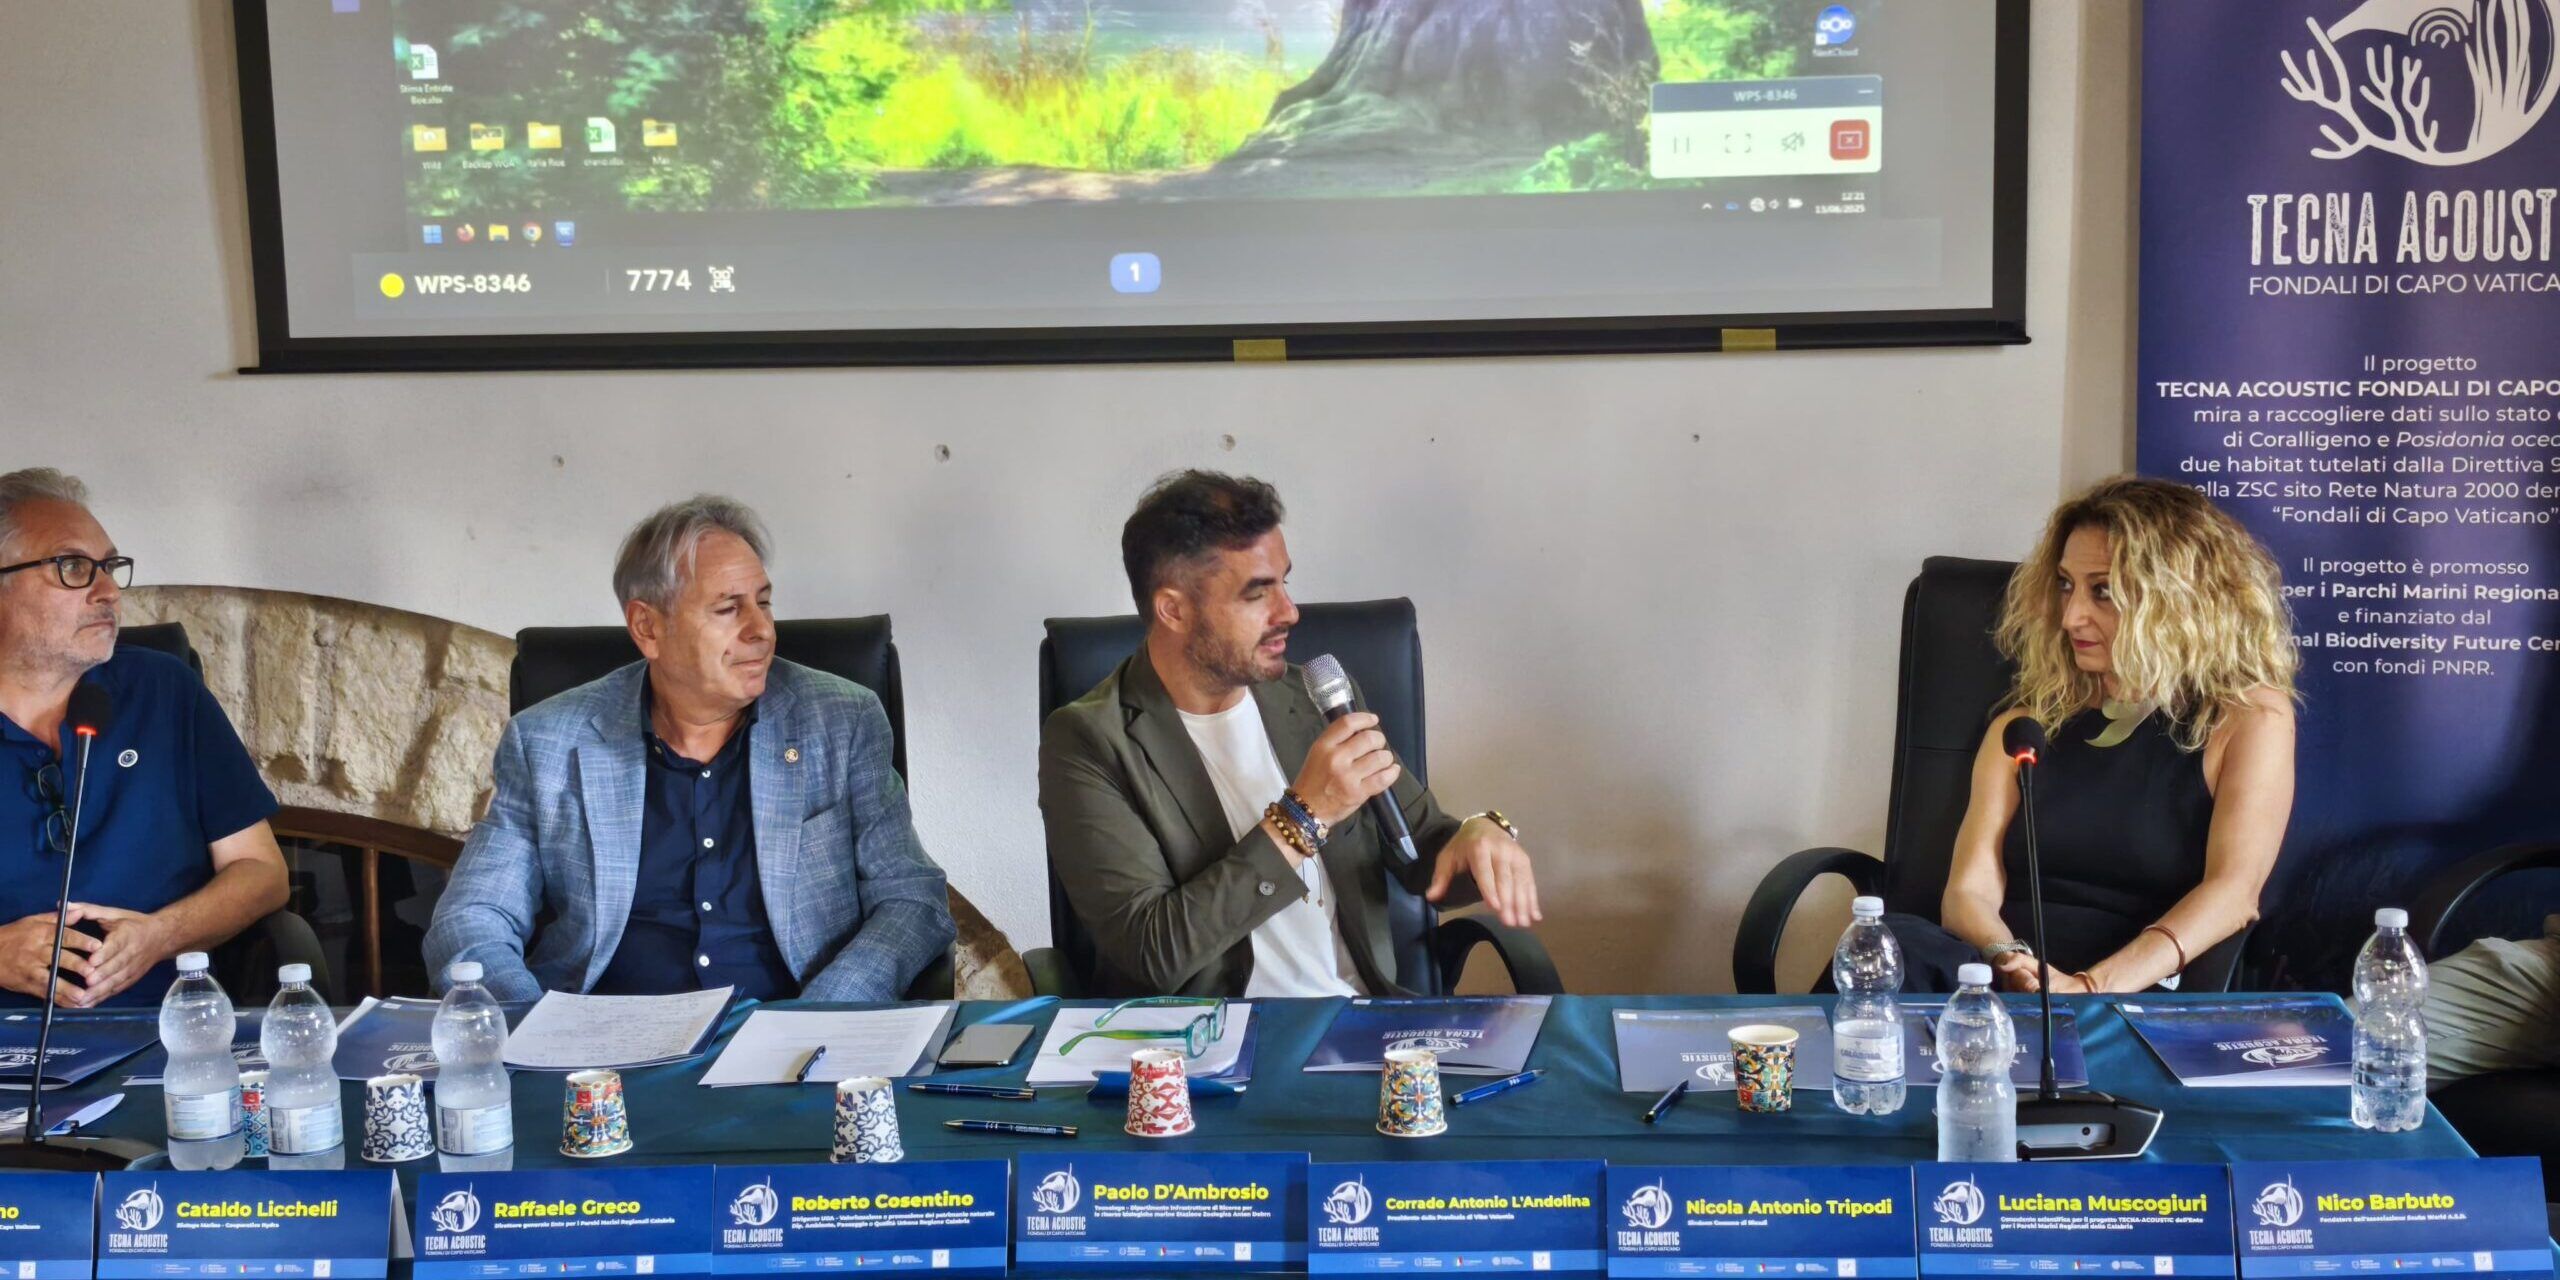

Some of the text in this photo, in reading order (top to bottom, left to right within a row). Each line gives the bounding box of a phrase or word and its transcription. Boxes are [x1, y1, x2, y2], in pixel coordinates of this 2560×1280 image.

[1733, 89, 1798, 102] WPS-8346
[2247, 189, 2557, 265] TECNA ACOUST
[1130, 262, 1140, 282] 1
[415, 269, 692, 295] WPS-8346 7774
[2250, 273, 2560, 295] FONDALI DI CAPO VATICA
[2365, 355, 2476, 375] Il progetto
[2157, 380, 2560, 397] TECNA ACOUSTIC FONDALI DI CAPO
[2195, 406, 2240, 422] mira
[2248, 410, 2259, 422] a
[2267, 406, 2384, 425] raccogliere
[2392, 405, 2432, 421] dati
[2440, 405, 2489, 421] sullo
[2496, 407, 2551, 421] stato
[2224, 431, 2242, 447] di
[2249, 431, 2370, 451] Coralligeno
[2377, 435, 2389, 447] e
[2397, 431, 2504, 447] Posidonia
[2181, 456, 2220, 472] due
[2228, 456, 2303, 472] habitat
[2309, 456, 2385, 472] tutelati
[2394, 456, 2444, 472] dalla
[2452, 456, 2543, 472] Direttiva
[2182, 481, 2229, 497] ella
[2237, 482, 2277, 497] ZSC
[2284, 481, 2321, 497] sito
[2329, 482, 2376, 497] Rete
[2385, 483, 2457, 498] Natura
[2465, 483, 2518, 498] 2000
[2273, 506, 2558, 527] “Fondali di Capo Vaticano”
[2304, 557, 2529, 577] Il progetto è promosso
[2321, 582, 2325, 597] i
[2333, 583, 2396, 598] Parchi
[2404, 584, 2467, 599] Marini
[2475, 584, 2558, 603] Regiona
[2337, 608, 2490, 624] e finanziato dal
[2326, 632, 2447, 653] Biodiversity
[2454, 635, 2521, 650] Future
[2333, 659, 2494, 675] con fondi PNRR.
[1681, 1054, 1732, 1062] COUSTIC
[792, 1190, 974, 1211] Roberto Cosentino
[1094, 1184, 1149, 1200] Paolo
[176, 1200, 338, 1218] Cataldo Licchelli
[494, 1199, 641, 1218] Raffaele Greco
[1386, 1197, 1445, 1210] Corrado
[1449, 1195, 1508, 1209] Antonio
[1686, 1198, 1892, 1217] Nicola Antonio Tripodi
[1999, 1193, 2207, 1215] Luciana Muscogiuri
[2317, 1193, 2455, 1211] Nico Barbuto
[1052, 1216, 1086, 1230] ACOUSTIC
[134, 1233, 168, 1248] ACOUSTIC
[450, 1234, 486, 1249] ACOUSTIC
[749, 1228, 783, 1242] ACOUSTIC
[1344, 1226, 1379, 1241] ACOUSTIC
[1644, 1231, 1680, 1246] ACOUSTIC
[1956, 1227, 1992, 1242] ACOUSTIC
[2276, 1229, 2313, 1245] ACOUSTIC
